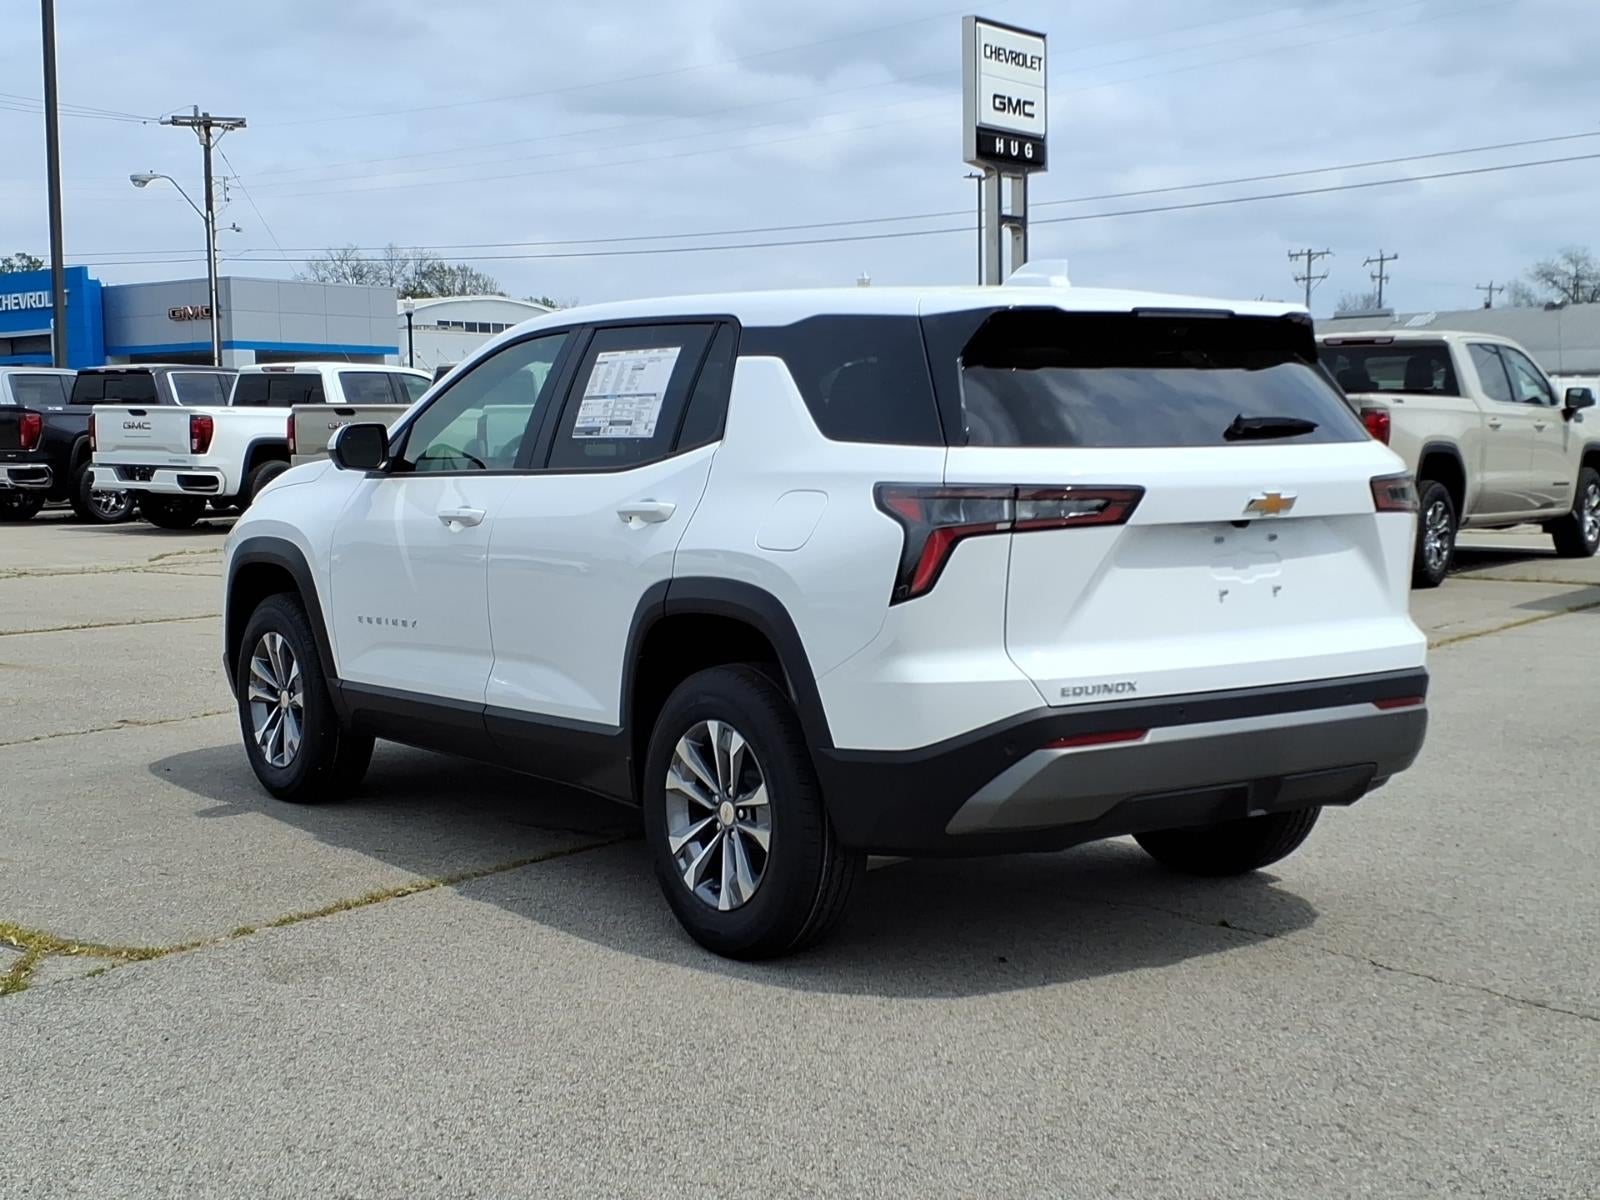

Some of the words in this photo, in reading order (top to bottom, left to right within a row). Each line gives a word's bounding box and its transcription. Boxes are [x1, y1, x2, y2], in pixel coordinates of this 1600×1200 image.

[983, 43, 1043, 73] CHEVROLET
[992, 93, 1035, 119] GMC
[122, 421, 152, 431] GMC
[1060, 681, 1137, 697] EQUINOX
